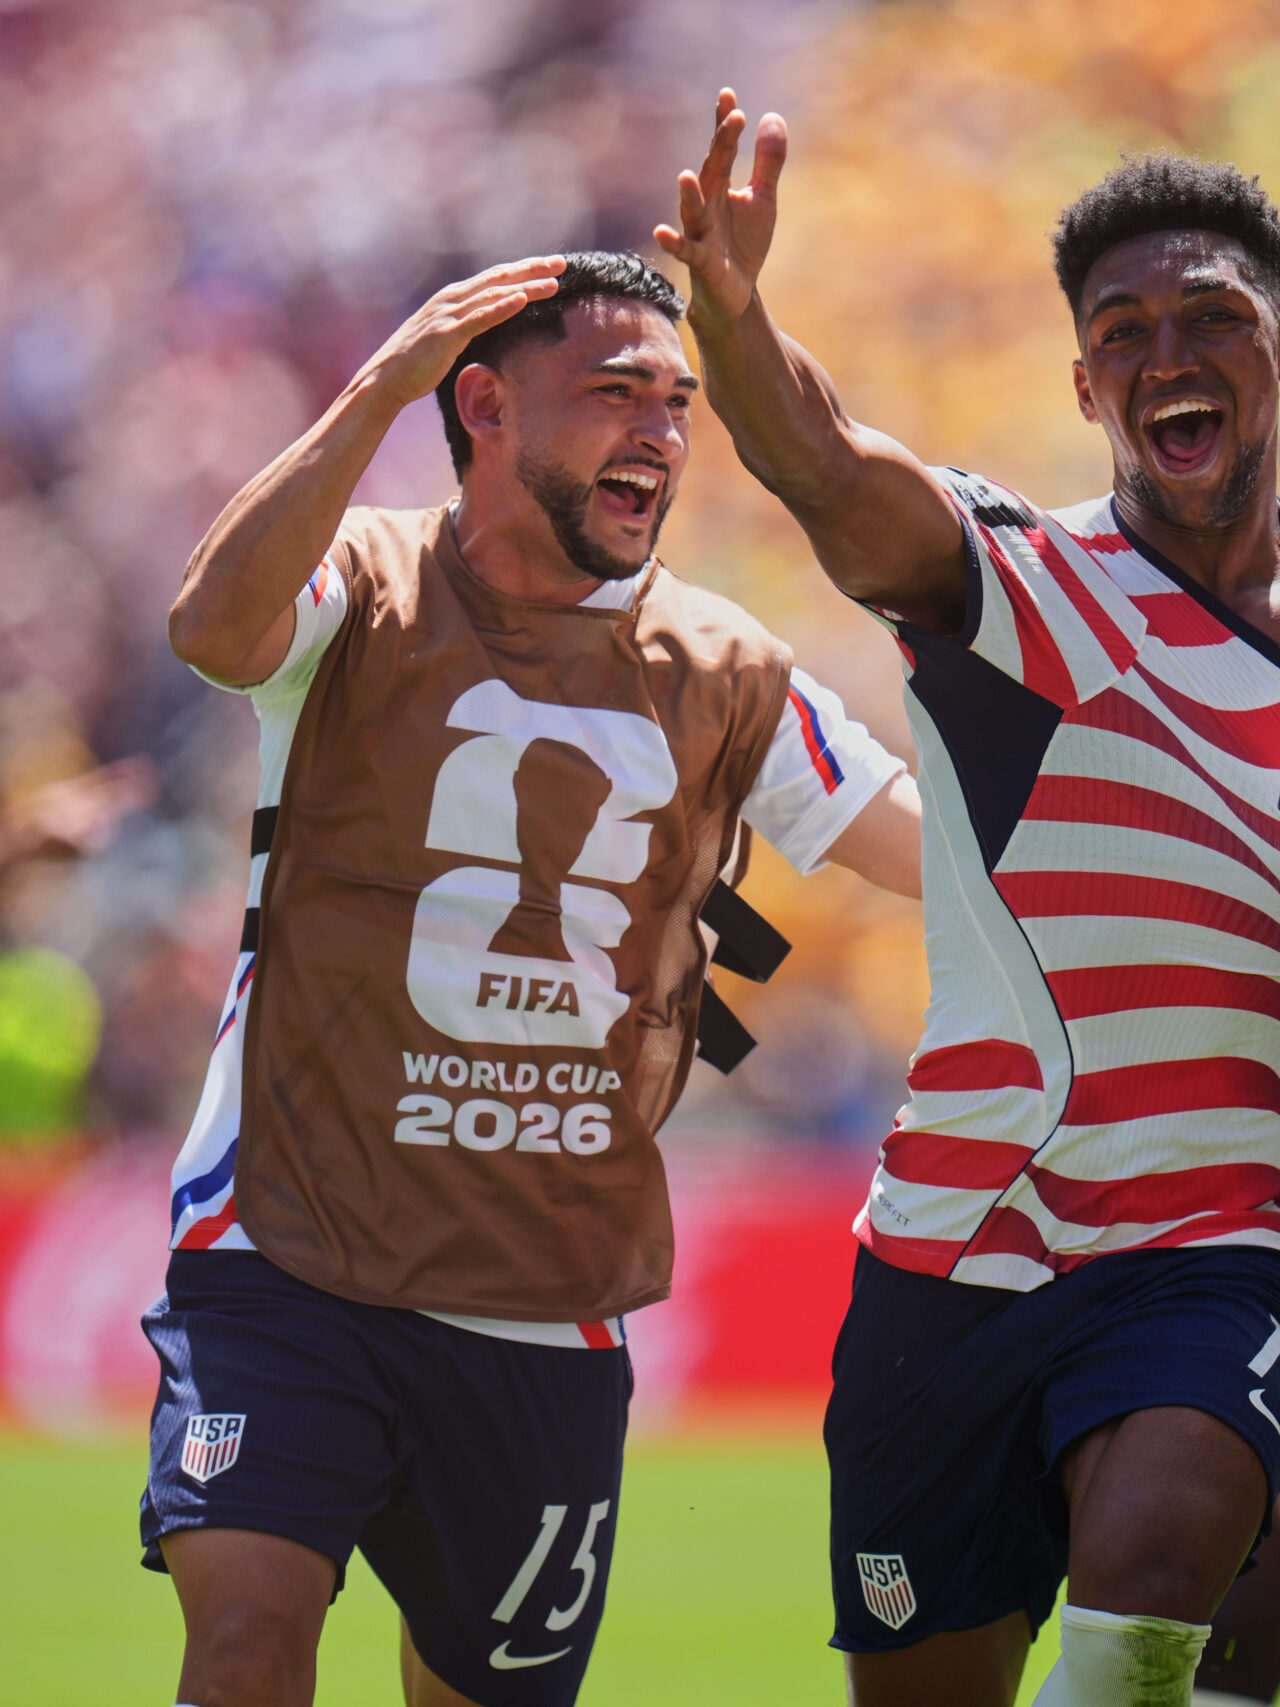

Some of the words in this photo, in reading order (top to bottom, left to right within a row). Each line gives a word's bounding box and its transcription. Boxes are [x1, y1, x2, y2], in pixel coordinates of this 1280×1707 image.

[475, 971, 580, 1018] FIFA
[402, 1050, 540, 1094] WORLD
[546, 1061, 622, 1095] CUP
[393, 1093, 612, 1156] 2026
[190, 1417, 242, 1443] USA
[490, 1498, 611, 1632] 15
[859, 1556, 904, 1588] USA
